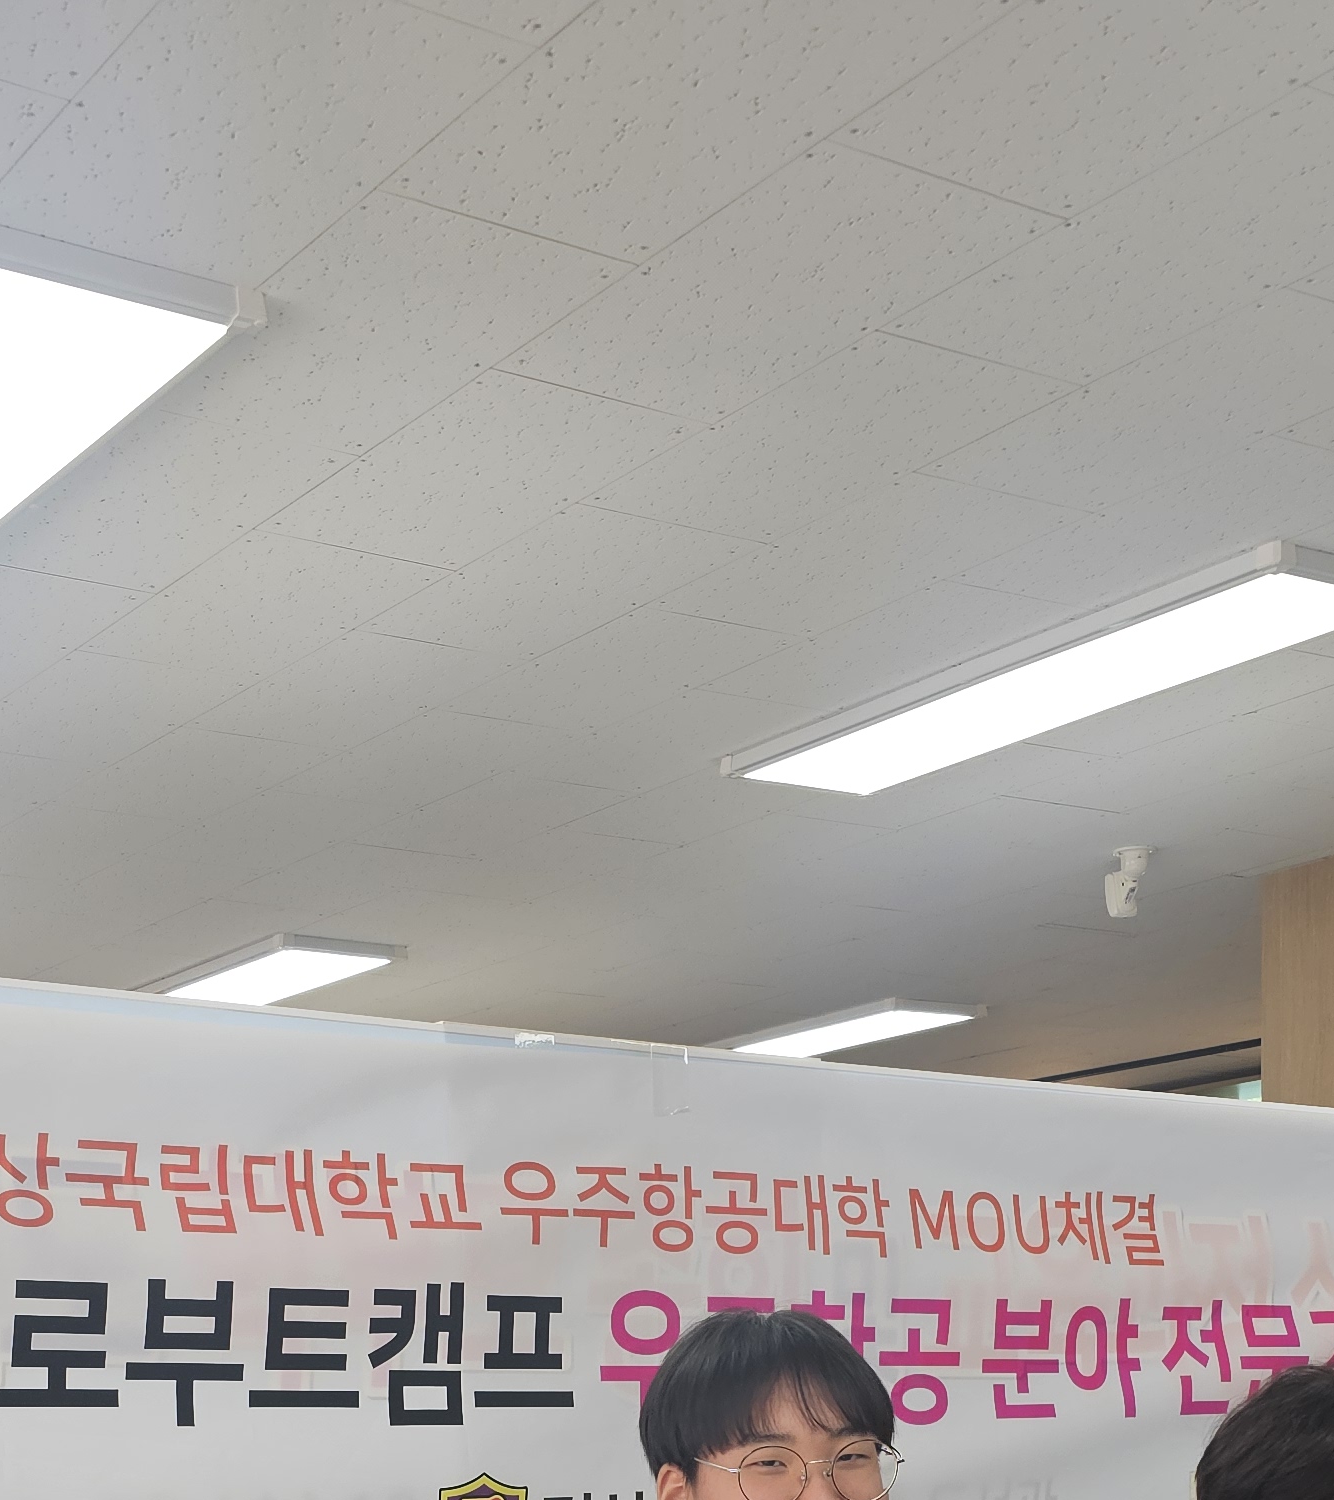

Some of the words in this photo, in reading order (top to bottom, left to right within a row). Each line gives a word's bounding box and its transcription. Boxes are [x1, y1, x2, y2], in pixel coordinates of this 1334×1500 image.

[499, 1160, 891, 1258] 우주항공대학
[908, 1187, 1166, 1267] MOU체결
[600, 1289, 961, 1426] 우공
[979, 1297, 1142, 1420] 분야
